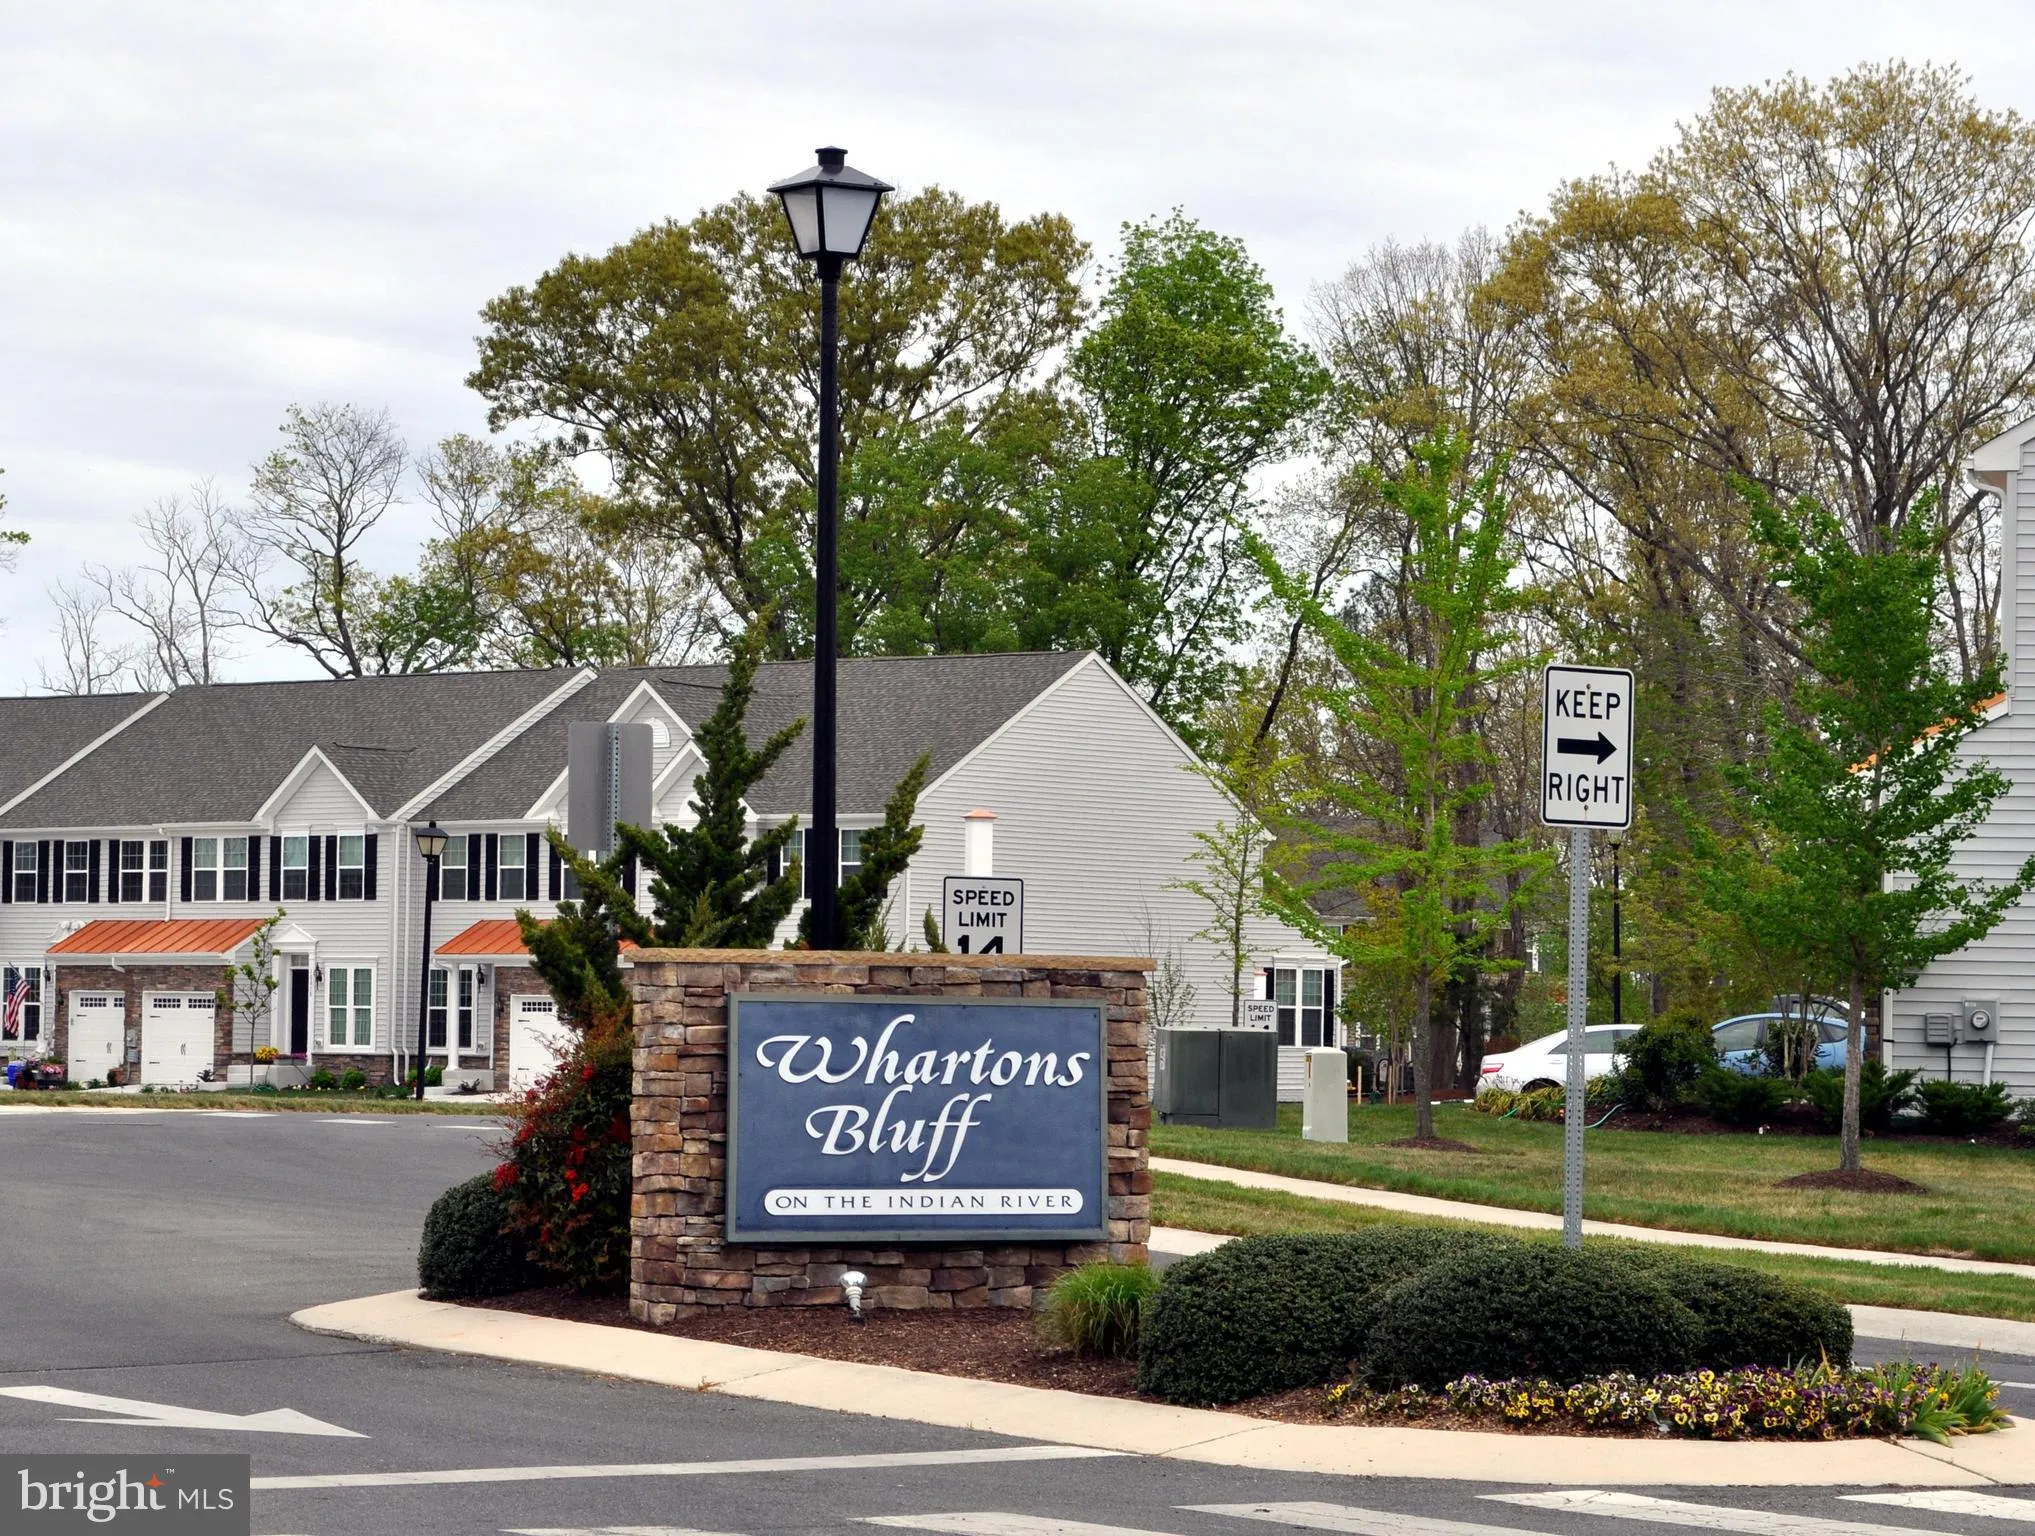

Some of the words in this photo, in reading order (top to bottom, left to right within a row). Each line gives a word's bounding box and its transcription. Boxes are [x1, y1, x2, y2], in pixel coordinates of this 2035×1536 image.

[1556, 689, 1621, 720] KEEP
[1549, 773, 1624, 803] RIGHT
[953, 889, 1015, 906] SPEED
[959, 911, 1007, 928] LIMIT
[756, 1013, 1091, 1087] Whartons
[805, 1084, 992, 1182] Bluff
[775, 1195, 807, 1208] ON
[823, 1195, 873, 1208] THE
[888, 1195, 984, 1208] INDIAN
[1000, 1194, 1073, 1208] RIVER
